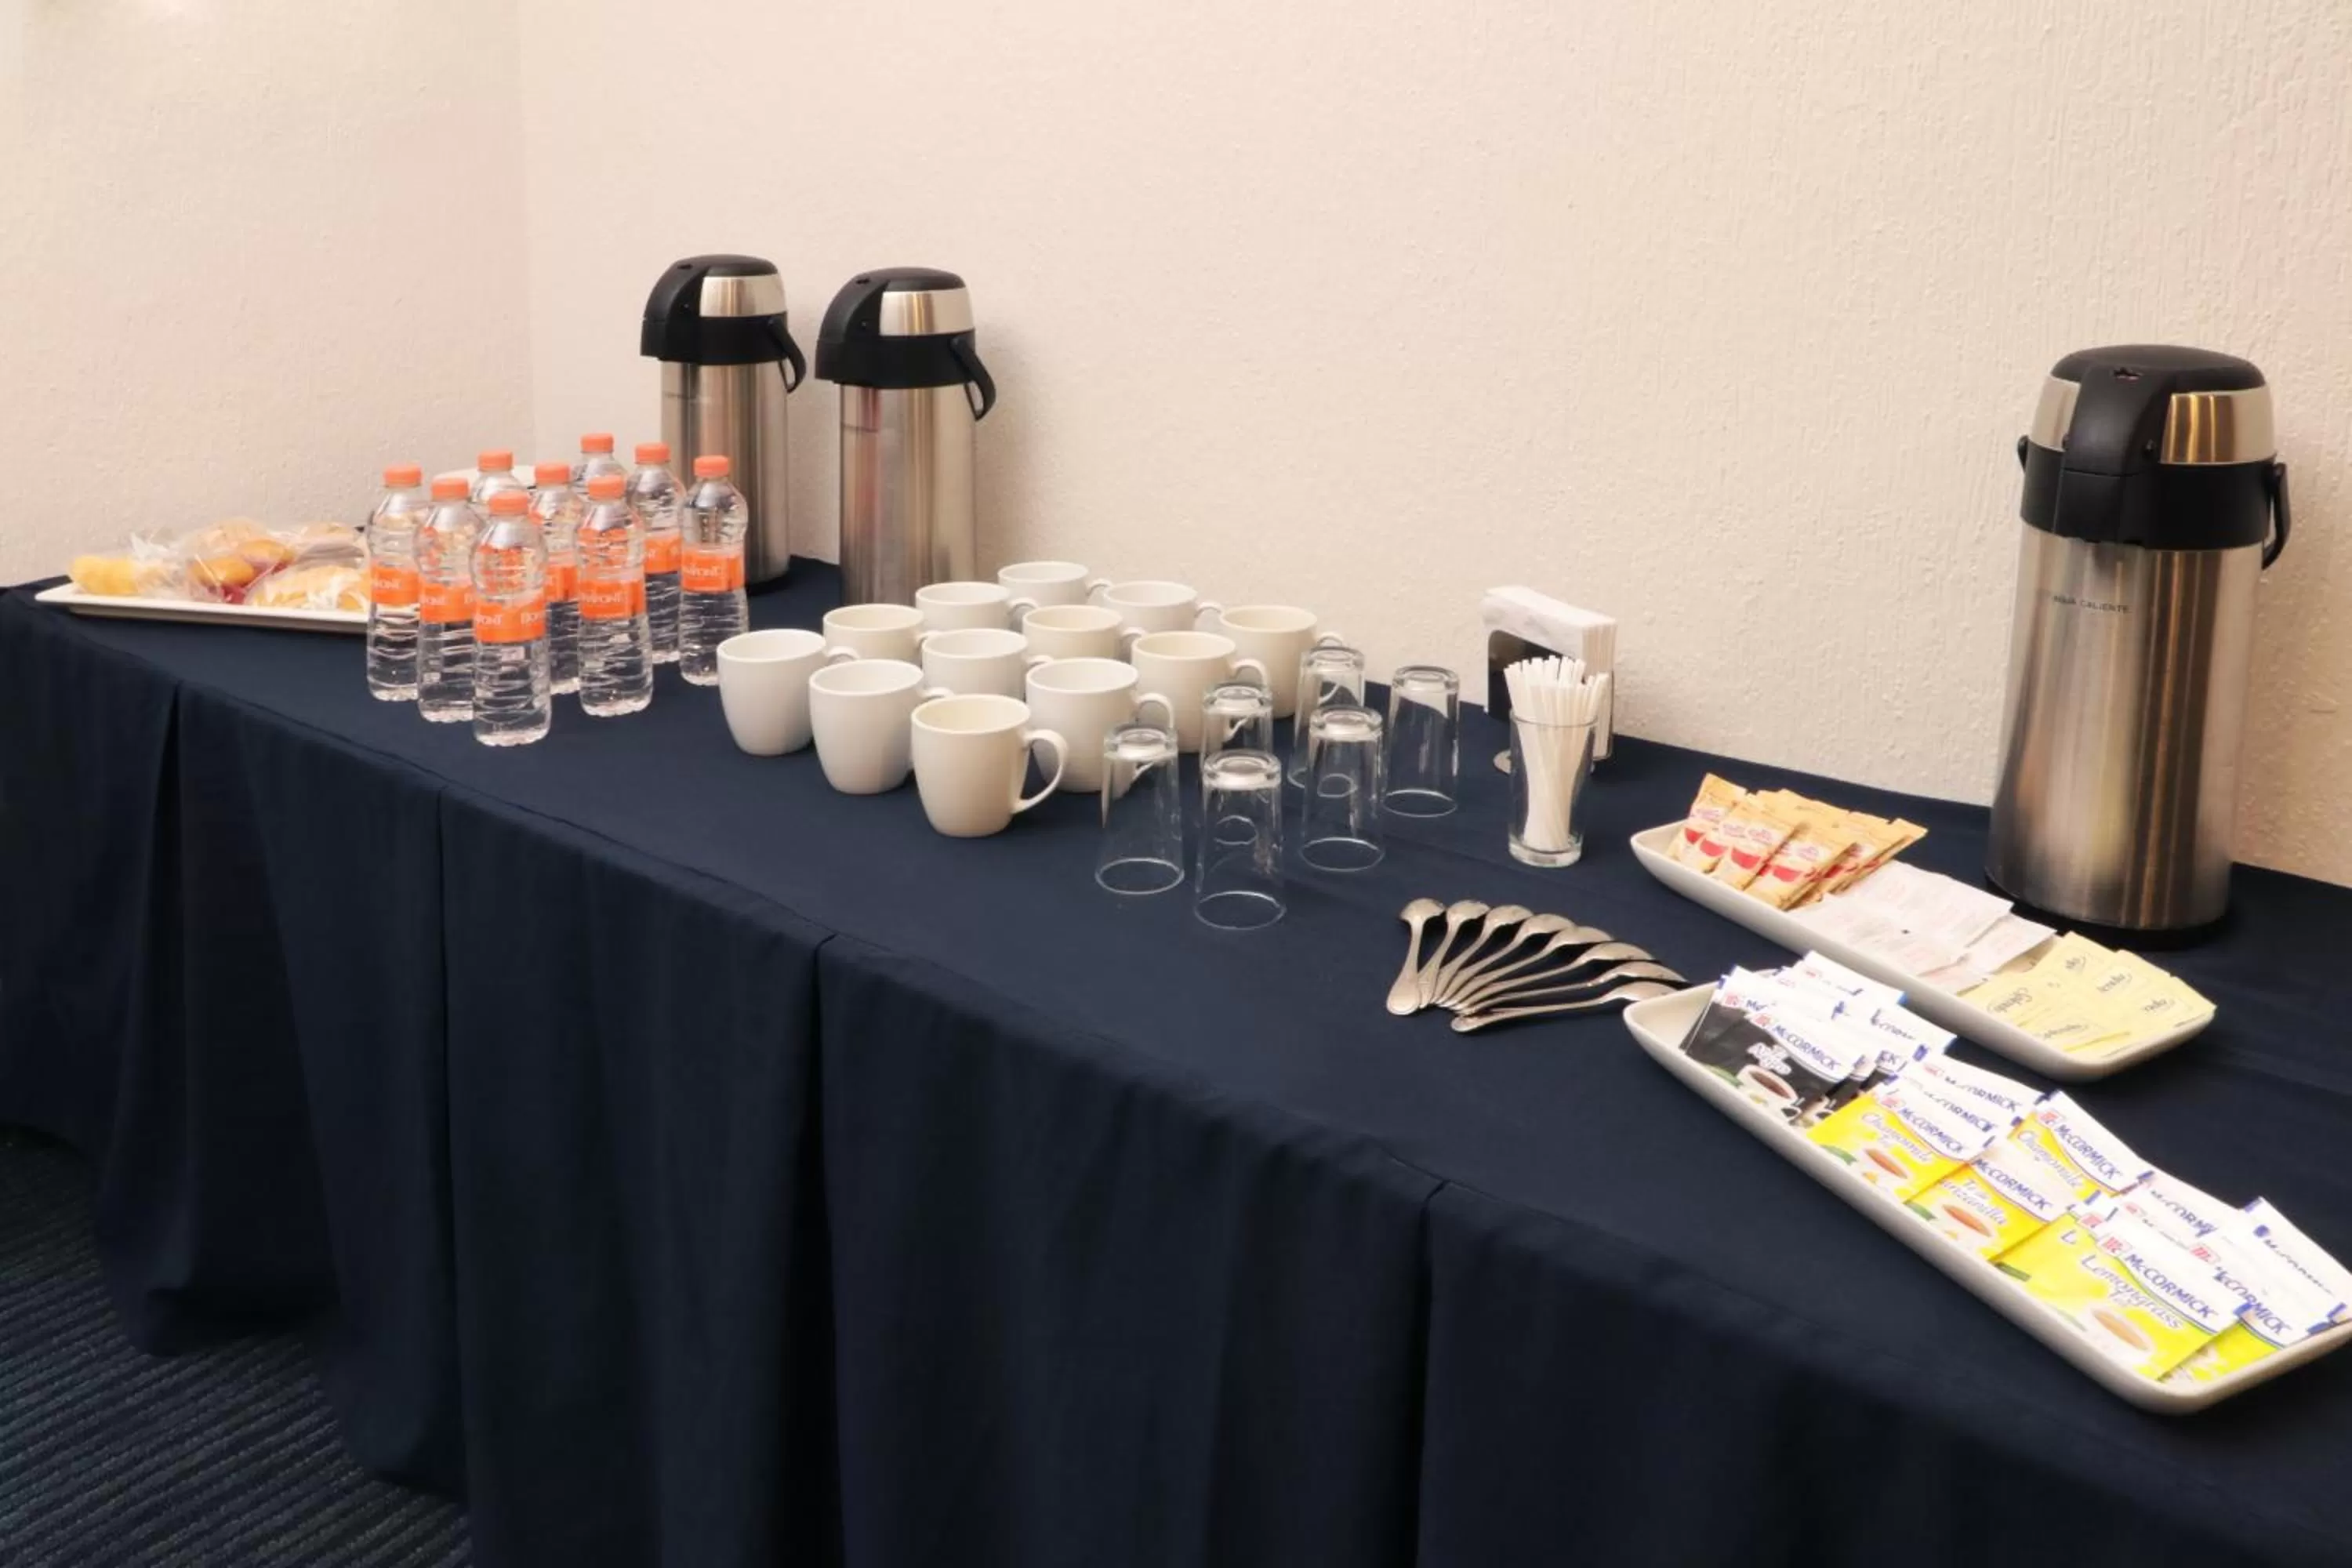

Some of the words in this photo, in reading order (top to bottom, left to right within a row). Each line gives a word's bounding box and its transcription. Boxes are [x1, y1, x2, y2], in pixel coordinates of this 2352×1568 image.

[1772, 1024, 1841, 1072] McCORMICK
[1900, 1106, 1966, 1153] McCORMICK
[2055, 1123, 2123, 1180] McCORMICK
[1972, 1157, 2054, 1211] McCORMICK
[2125, 1253, 2220, 1320] McCORMICK
